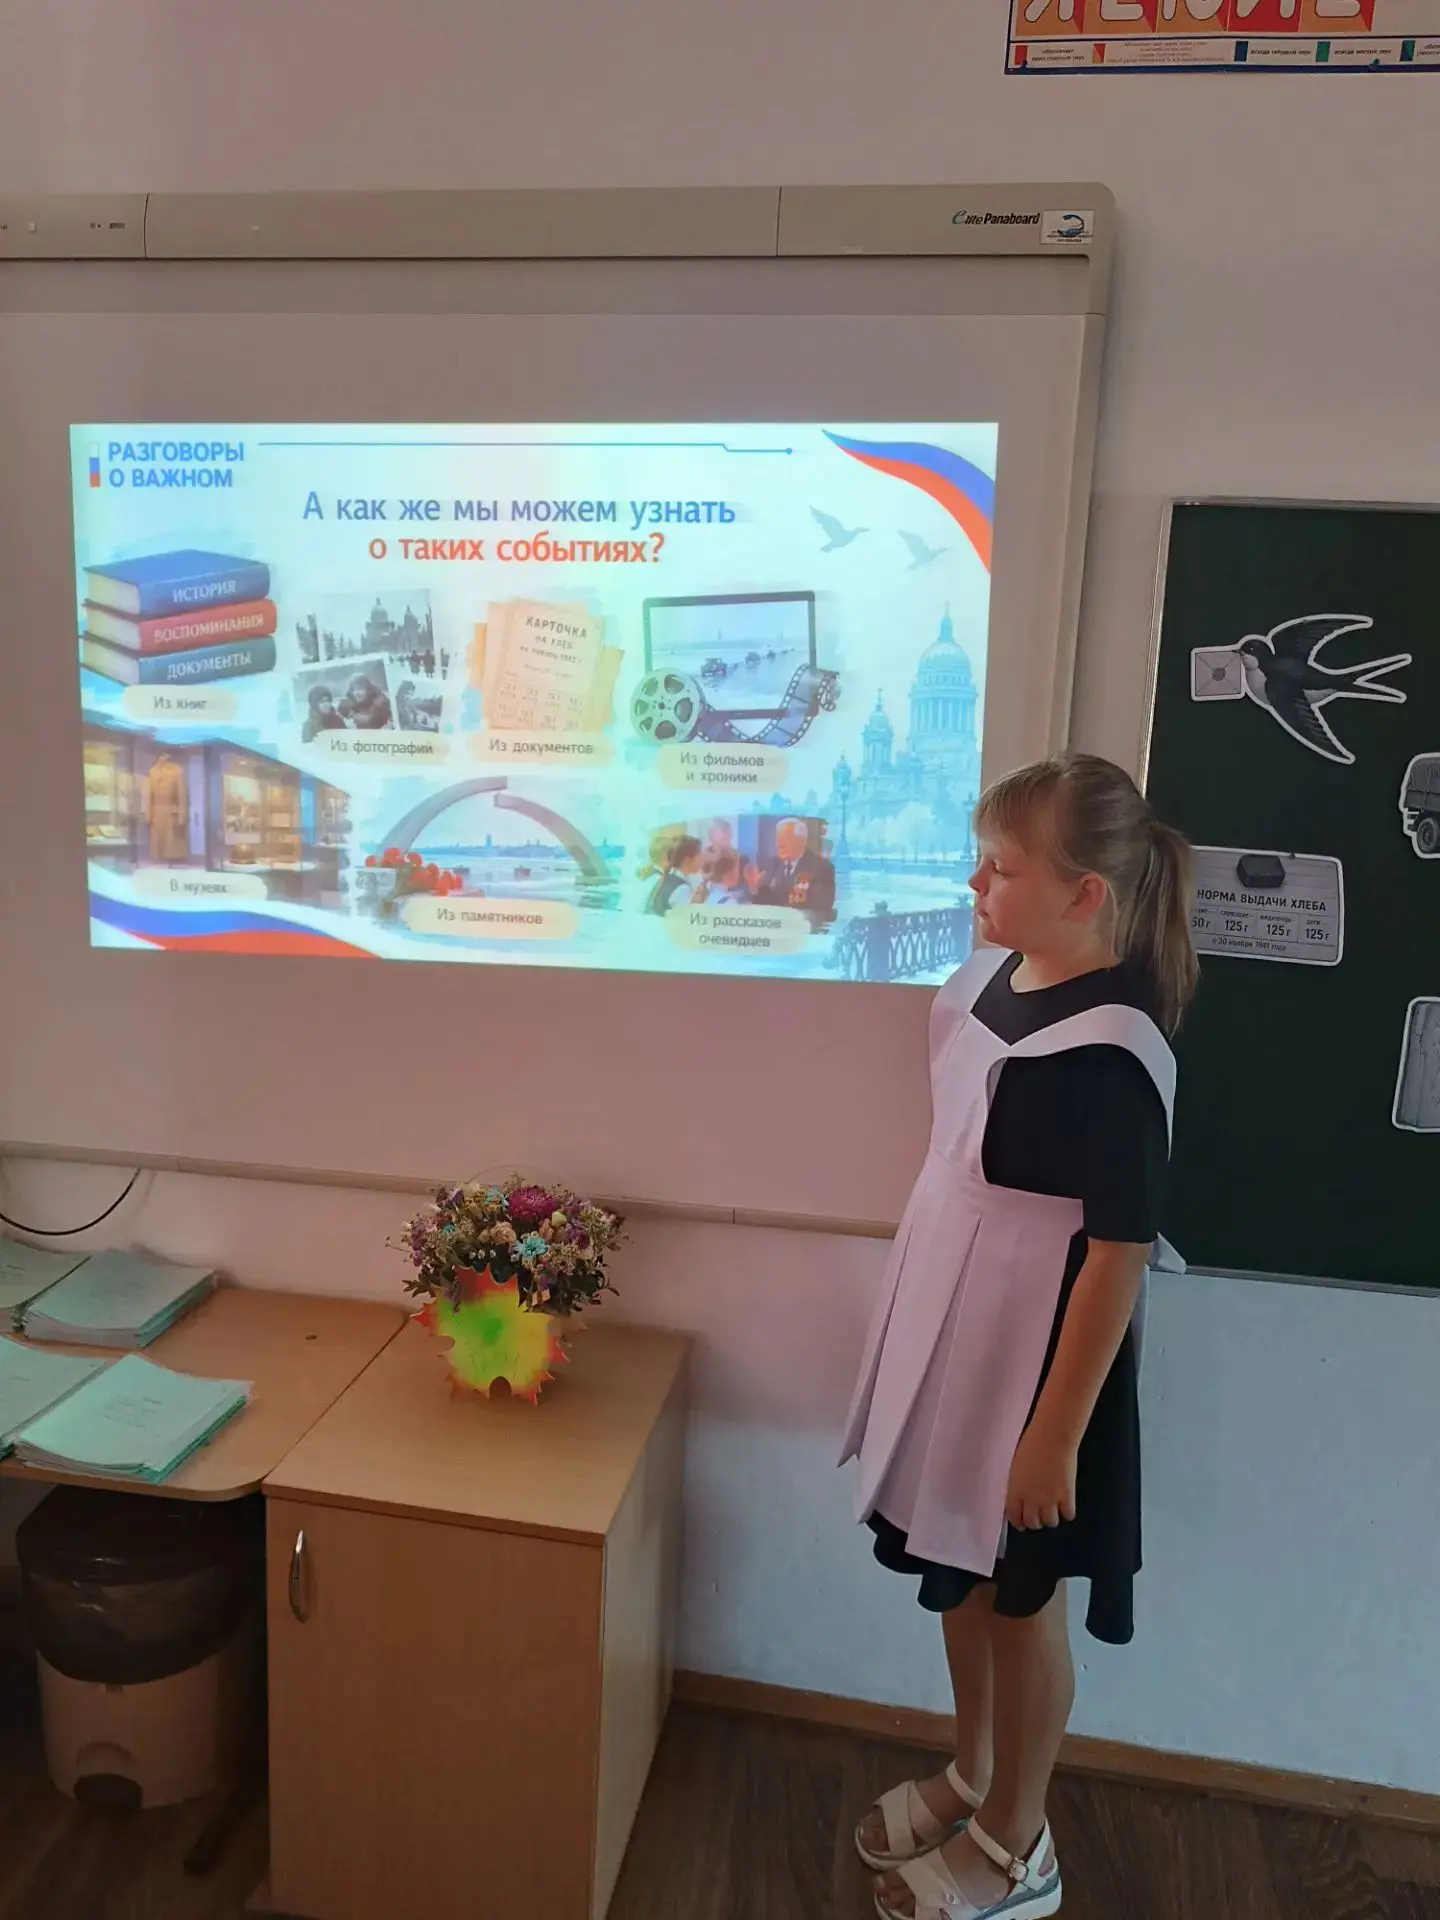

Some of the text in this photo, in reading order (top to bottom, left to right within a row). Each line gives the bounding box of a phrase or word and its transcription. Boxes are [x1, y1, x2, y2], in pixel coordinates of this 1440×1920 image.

[984, 213, 1040, 225] Panaboard
[108, 441, 244, 462] РАЗГОВОРЫ
[109, 468, 233, 488] О ВАЖНОМ
[302, 491, 736, 530] А как же мы можем узнать
[369, 531, 665, 564] о таких событиях?
[173, 580, 236, 603] ИСТОРИЯ
[154, 613, 264, 644] ВОСПОМИНАНИЯ
[526, 616, 587, 637] КАРТОЧКА
[167, 653, 251, 681] ДОКУМЕНТЫ
[154, 696, 207, 710] Из книг
[330, 739, 348, 752] Из
[490, 738, 593, 757] Из документов
[680, 752, 764, 767] Из фильмов
[686, 772, 757, 784] и хроники
[1197, 889, 1327, 912] НОРМА ВЫДАЧИ ХЛЕБА
[436, 908, 543, 925] Из памятников
[690, 912, 782, 930] Из рассказов
[1225, 919, 1242, 932] 125
[1267, 924, 1285, 936] 125
[1305, 928, 1324, 940] 125
[699, 934, 770, 948] очевидцев
